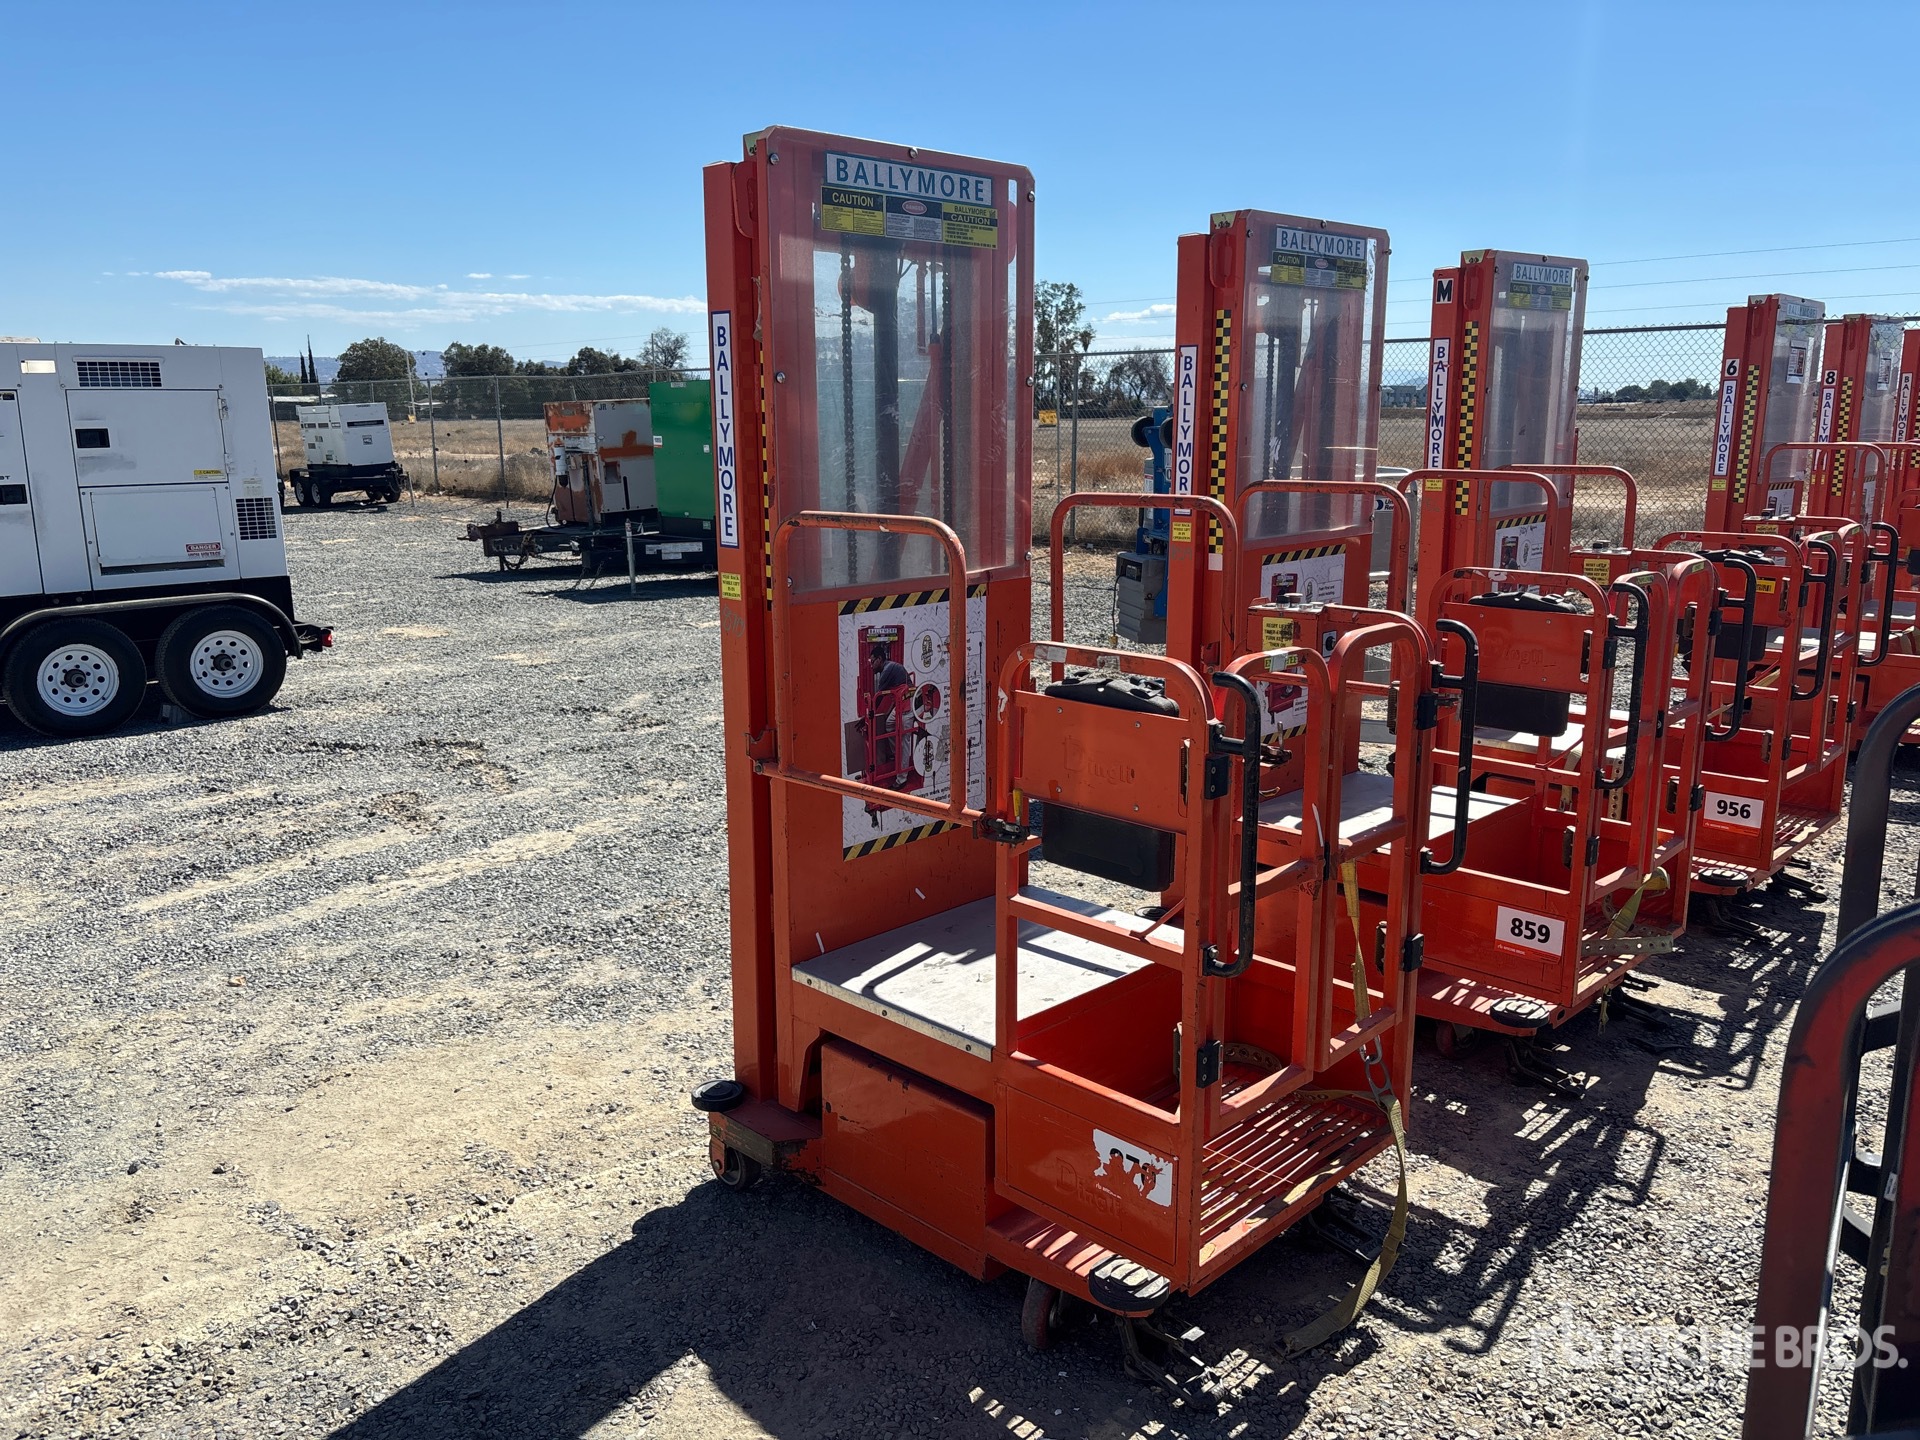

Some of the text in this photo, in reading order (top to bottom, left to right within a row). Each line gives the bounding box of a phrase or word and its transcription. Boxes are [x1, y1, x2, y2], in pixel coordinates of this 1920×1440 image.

[836, 158, 984, 202] BALLYMORE
[832, 192, 874, 207] CAUTION
[950, 213, 991, 226] CAUTION
[954, 205, 987, 217] BALLYMORE
[1281, 230, 1361, 257] BALLYMORE
[1277, 255, 1300, 264] CAUTION
[1515, 265, 1570, 283] BALLYMORE
[1436, 280, 1453, 302] M
[1726, 360, 1737, 376] 6
[1825, 371, 1836, 385] 8
[1431, 346, 1446, 468] BALLYMORE
[716, 325, 734, 537] BALLYMORE
[1178, 355, 1193, 495] BALLYMOR
[1717, 385, 1733, 472] BALLYMORE
[1717, 799, 1751, 819] 956
[1510, 917, 1551, 944] 859
